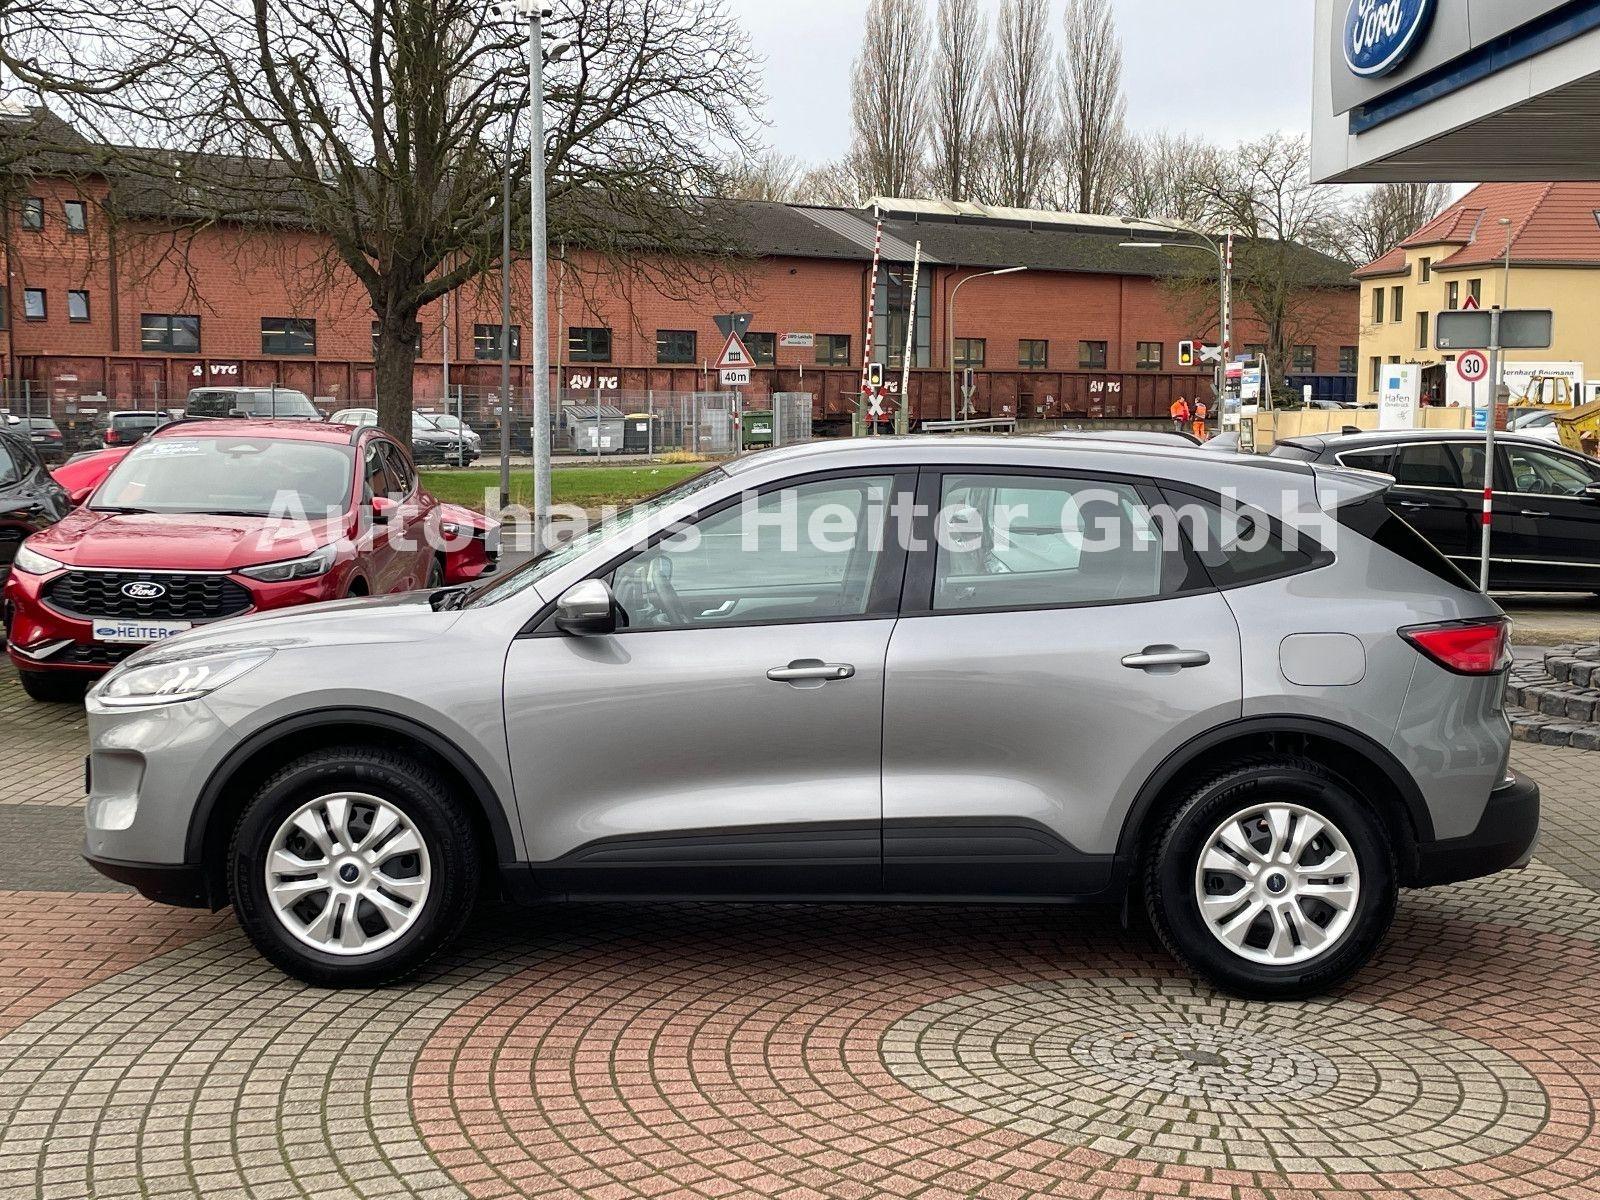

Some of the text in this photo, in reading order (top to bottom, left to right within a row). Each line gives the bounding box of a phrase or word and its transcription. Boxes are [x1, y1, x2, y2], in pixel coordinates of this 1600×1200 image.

[1353, 0, 1403, 54] Ford
[210, 365, 238, 375] VTG
[1465, 359, 1480, 374] 30
[1385, 393, 1410, 403] Hafen
[129, 584, 158, 596] Ford
[117, 627, 168, 638] HEITER
